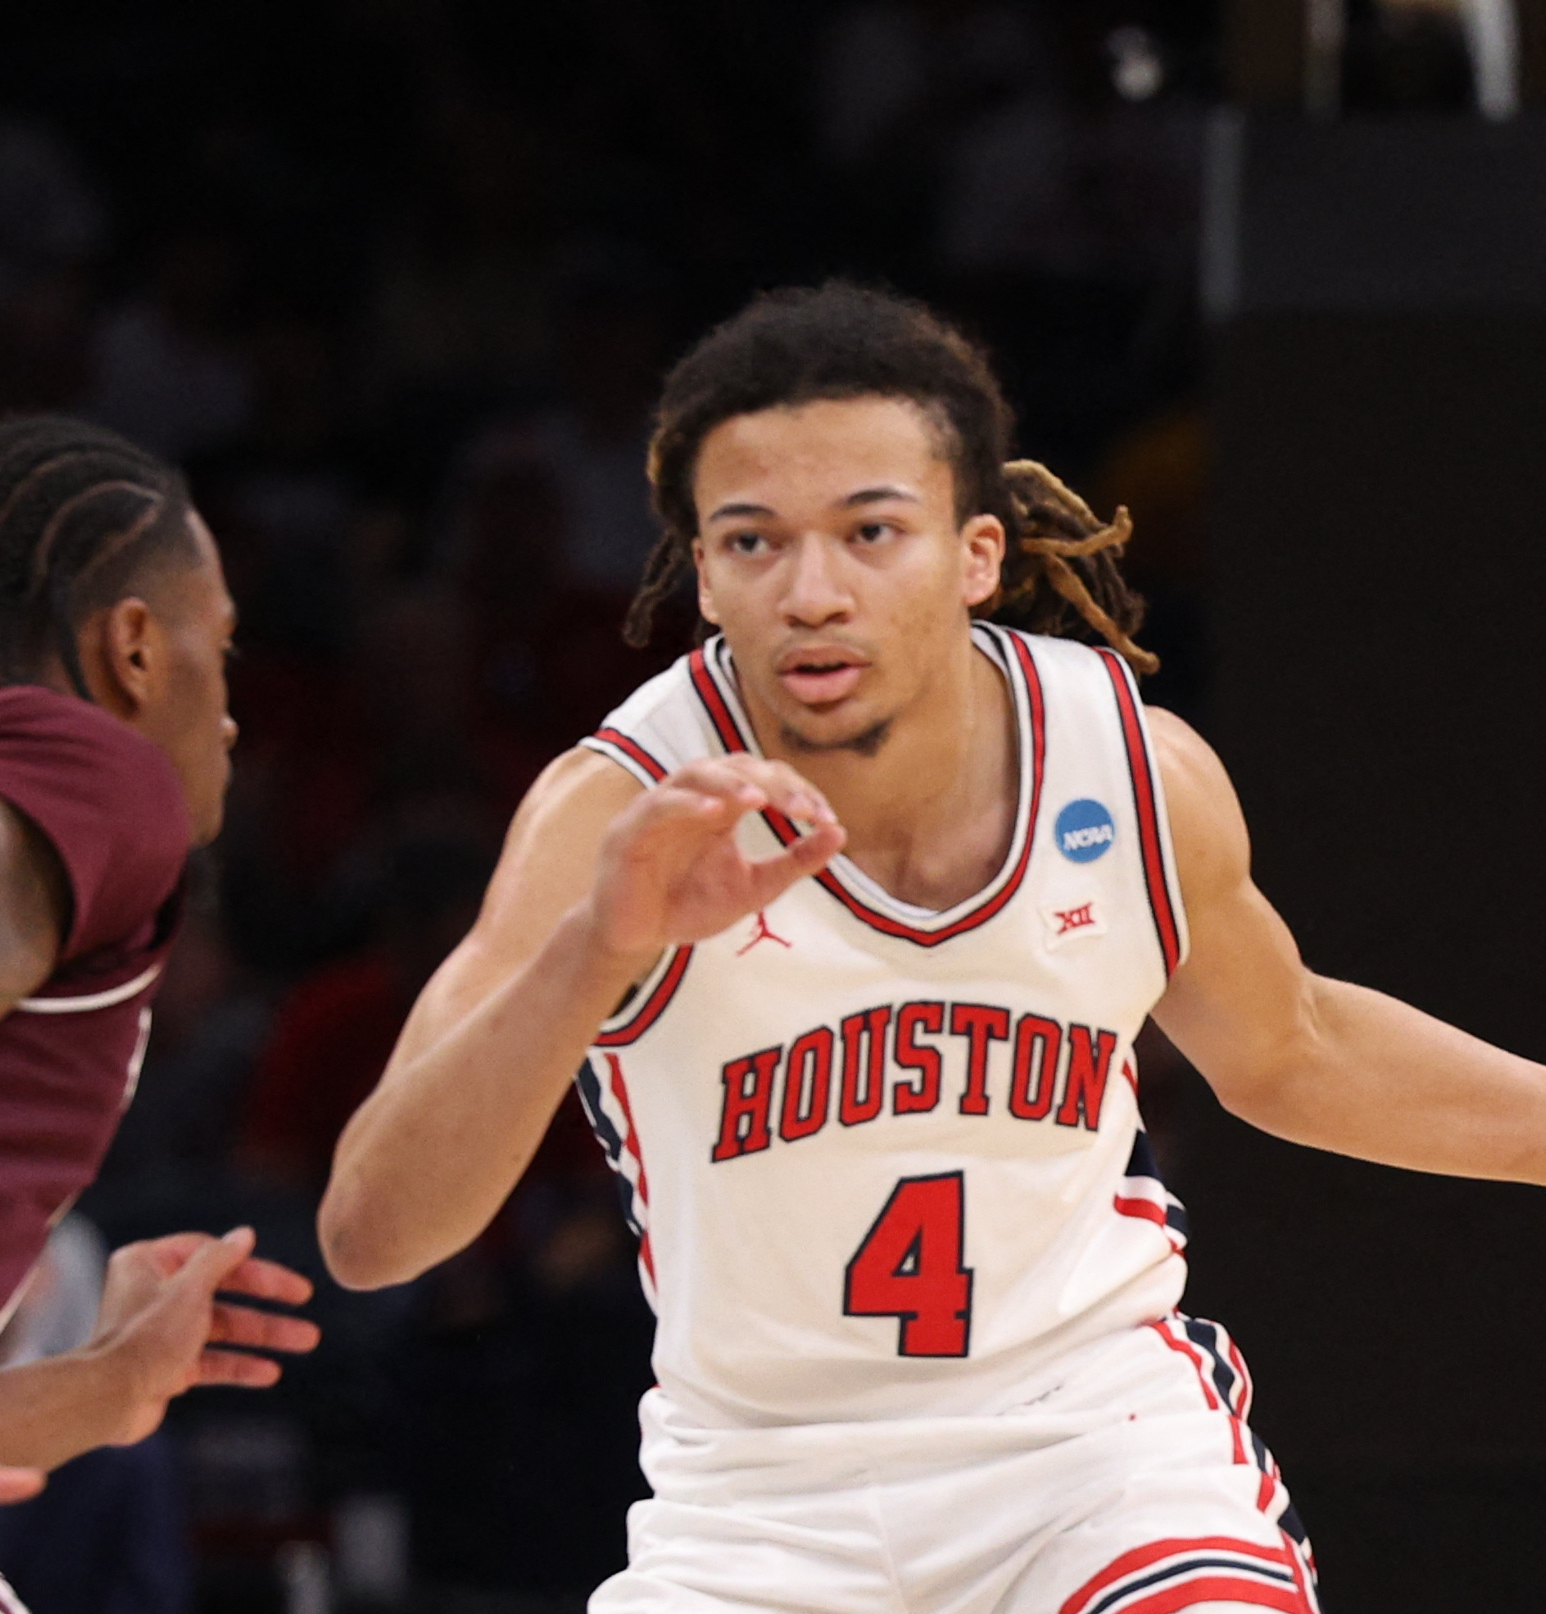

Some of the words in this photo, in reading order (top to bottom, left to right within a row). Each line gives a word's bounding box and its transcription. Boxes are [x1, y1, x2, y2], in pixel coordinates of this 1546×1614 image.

[1063, 823, 1114, 851] NCAA
[711, 1001, 1118, 1163] HOUSTON
[842, 1169, 975, 1359] 4
